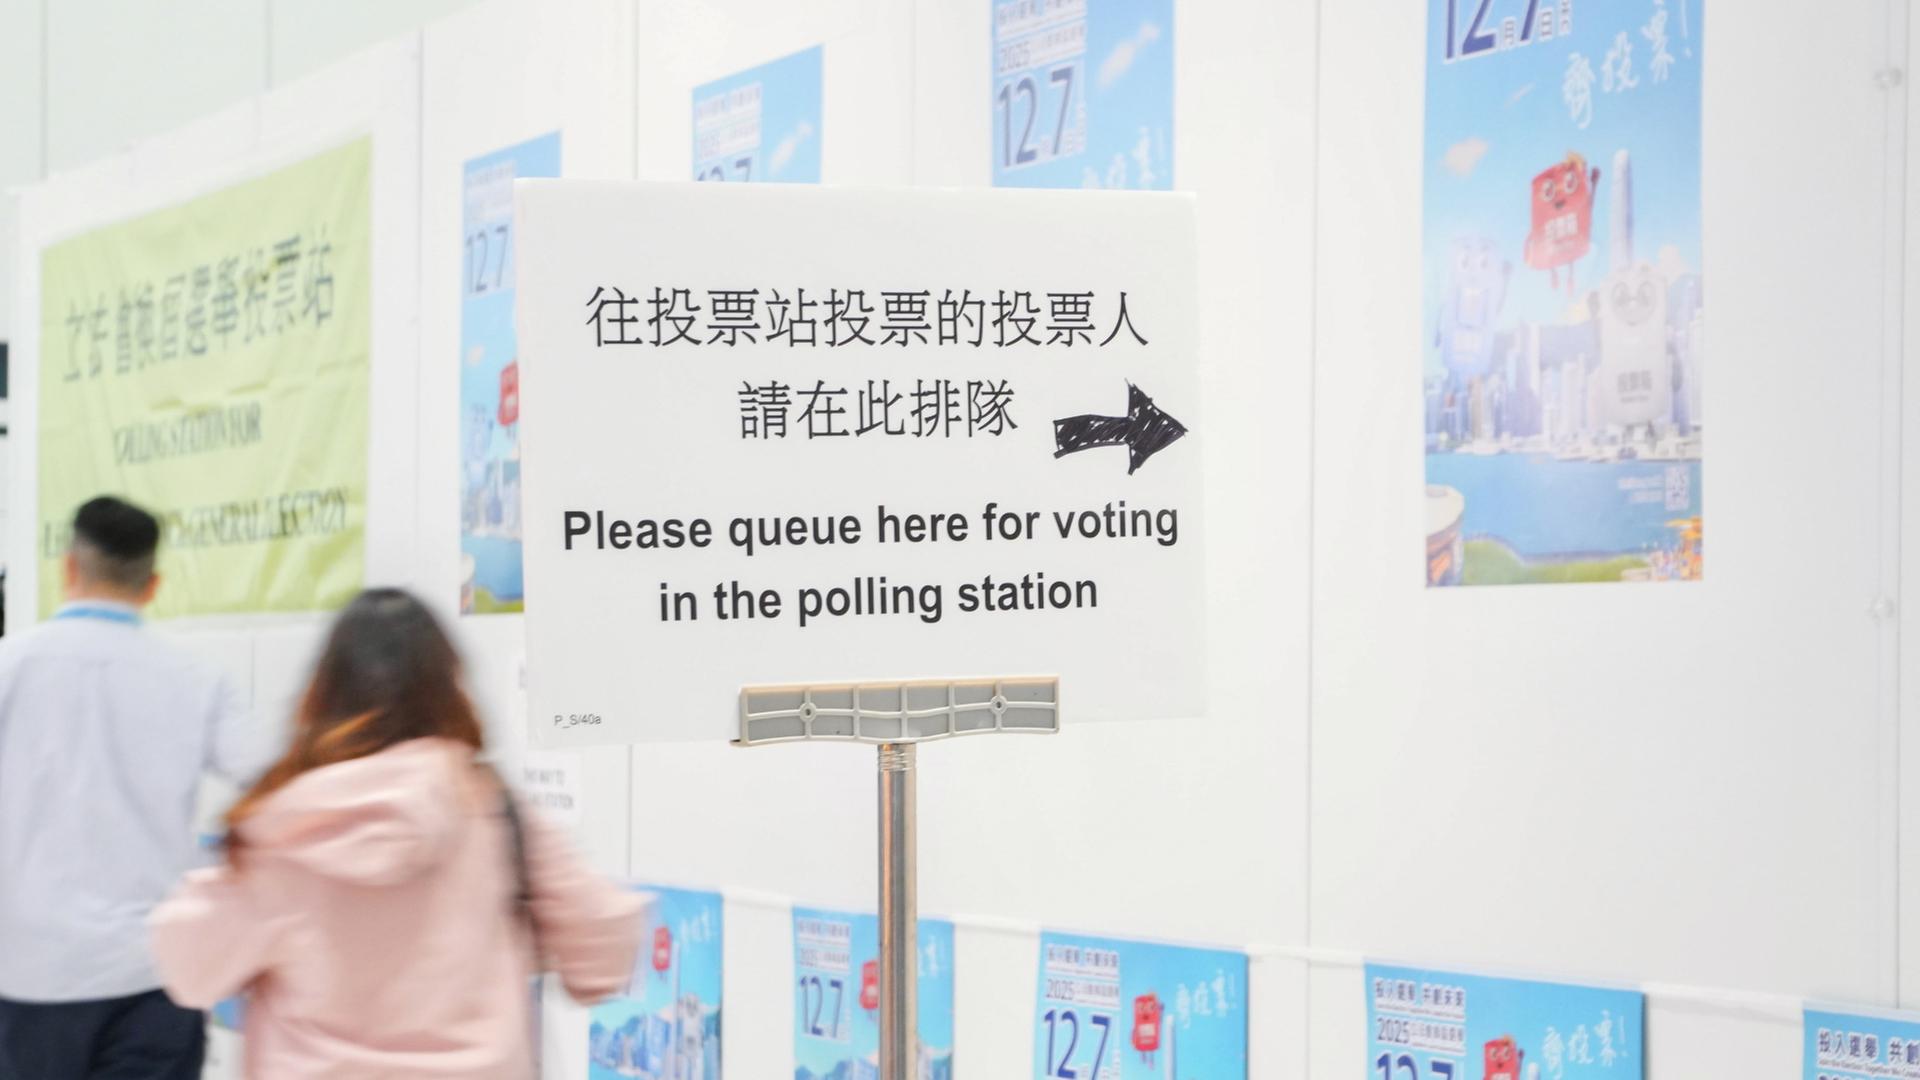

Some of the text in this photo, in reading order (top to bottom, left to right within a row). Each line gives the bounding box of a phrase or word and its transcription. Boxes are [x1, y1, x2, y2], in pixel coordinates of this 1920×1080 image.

[587, 287, 1148, 347] 往投票站投票的投票人
[738, 380, 1017, 439] 請在此排隊
[565, 501, 1177, 556] Please queue here for voting
[661, 572, 1096, 627] in the polling station
